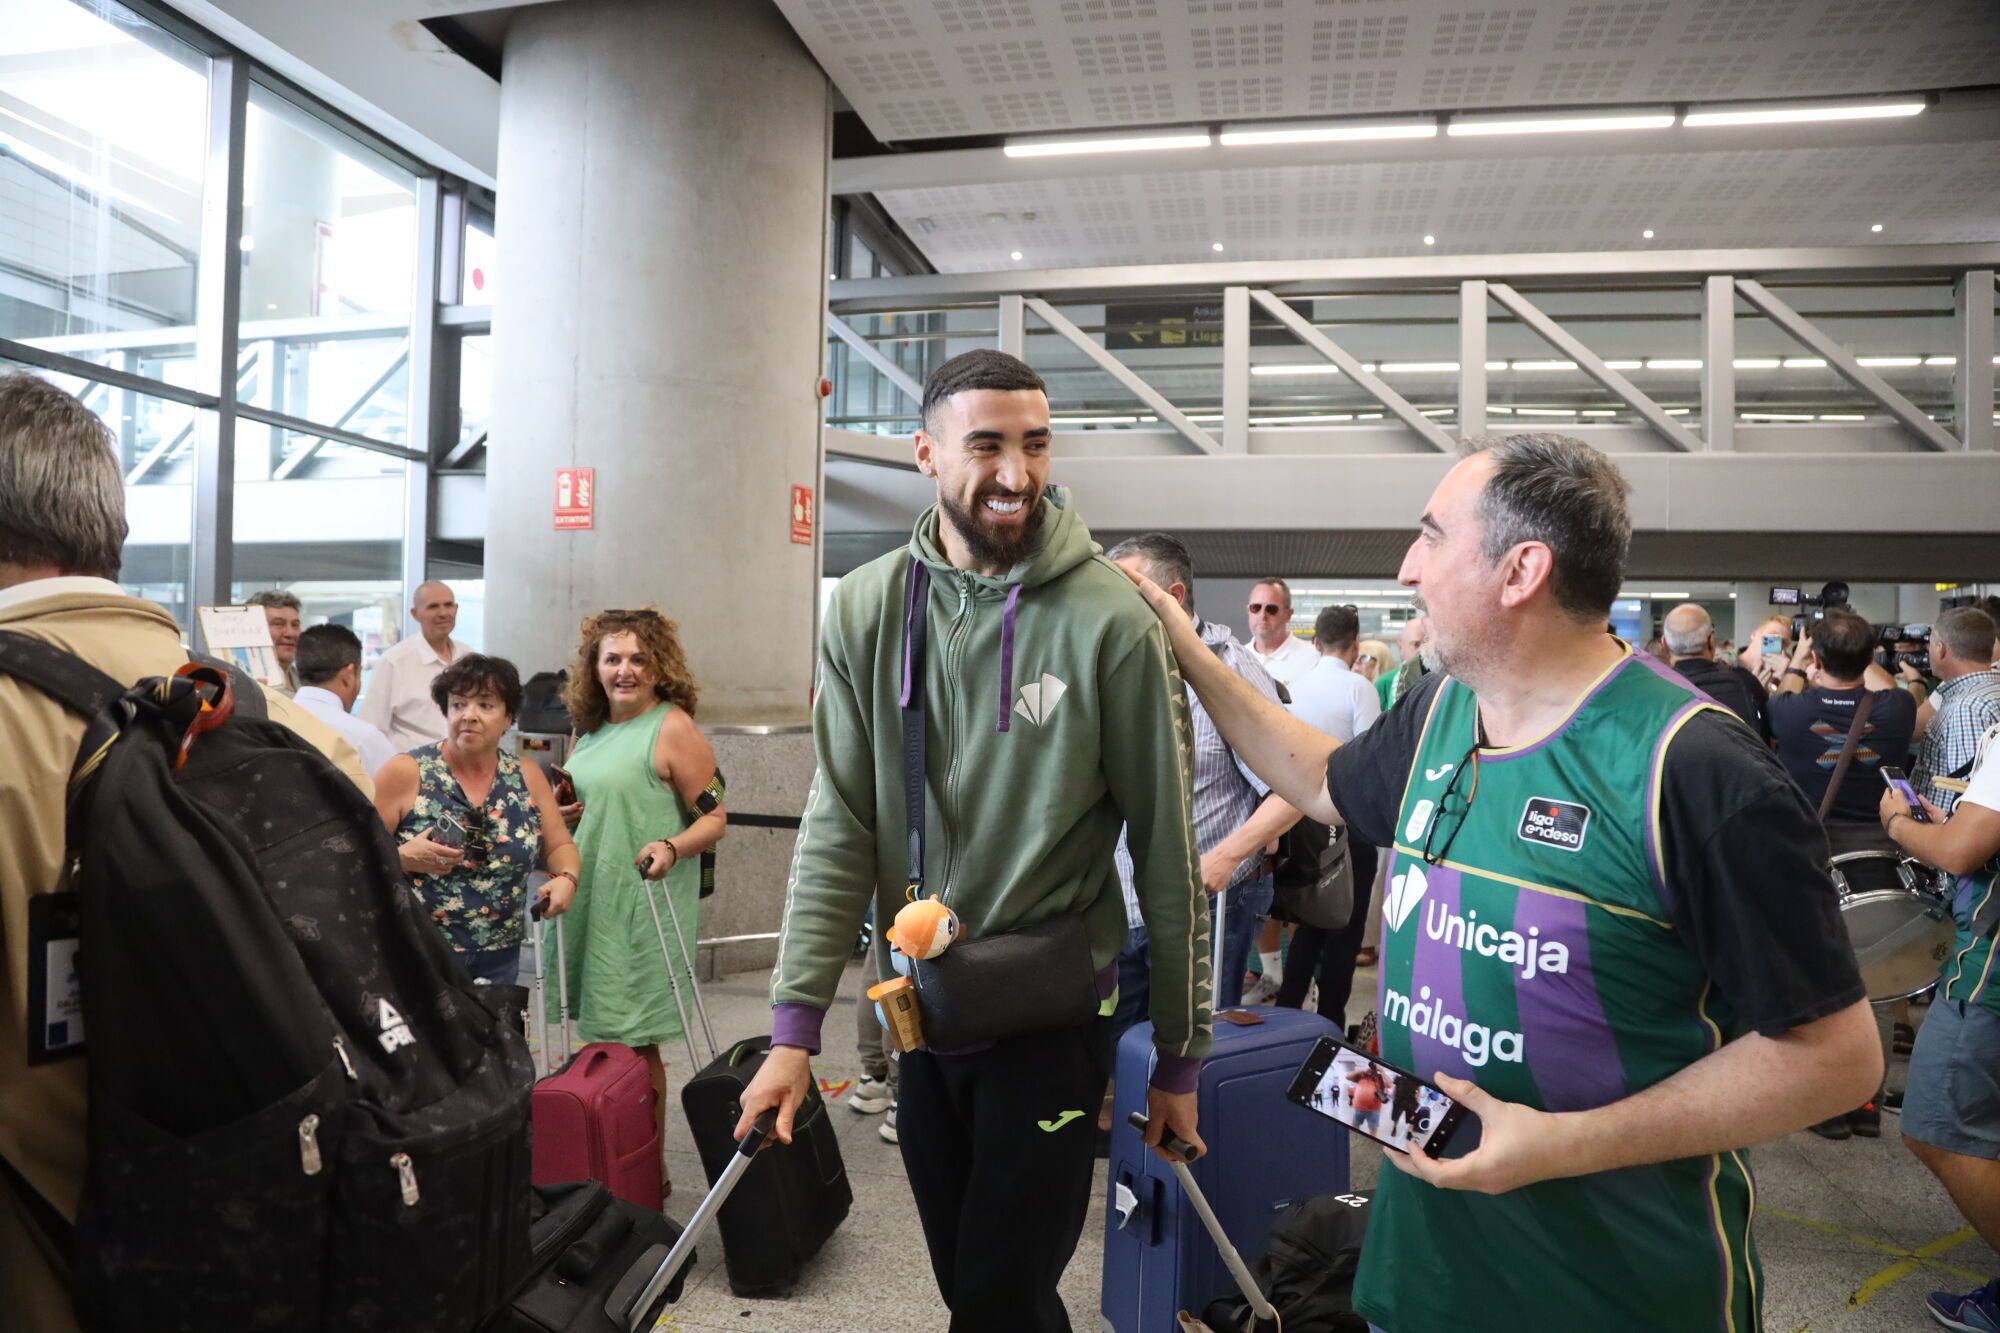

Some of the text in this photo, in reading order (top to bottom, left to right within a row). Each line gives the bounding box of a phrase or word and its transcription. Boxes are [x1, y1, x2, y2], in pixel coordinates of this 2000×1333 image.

[1192, 329, 1224, 343] Llega
[555, 515, 589, 524] EXTINTOR
[1528, 810, 1554, 826] liga
[1525, 824, 1579, 844] endesa
[1426, 898, 1569, 980] Unicaja
